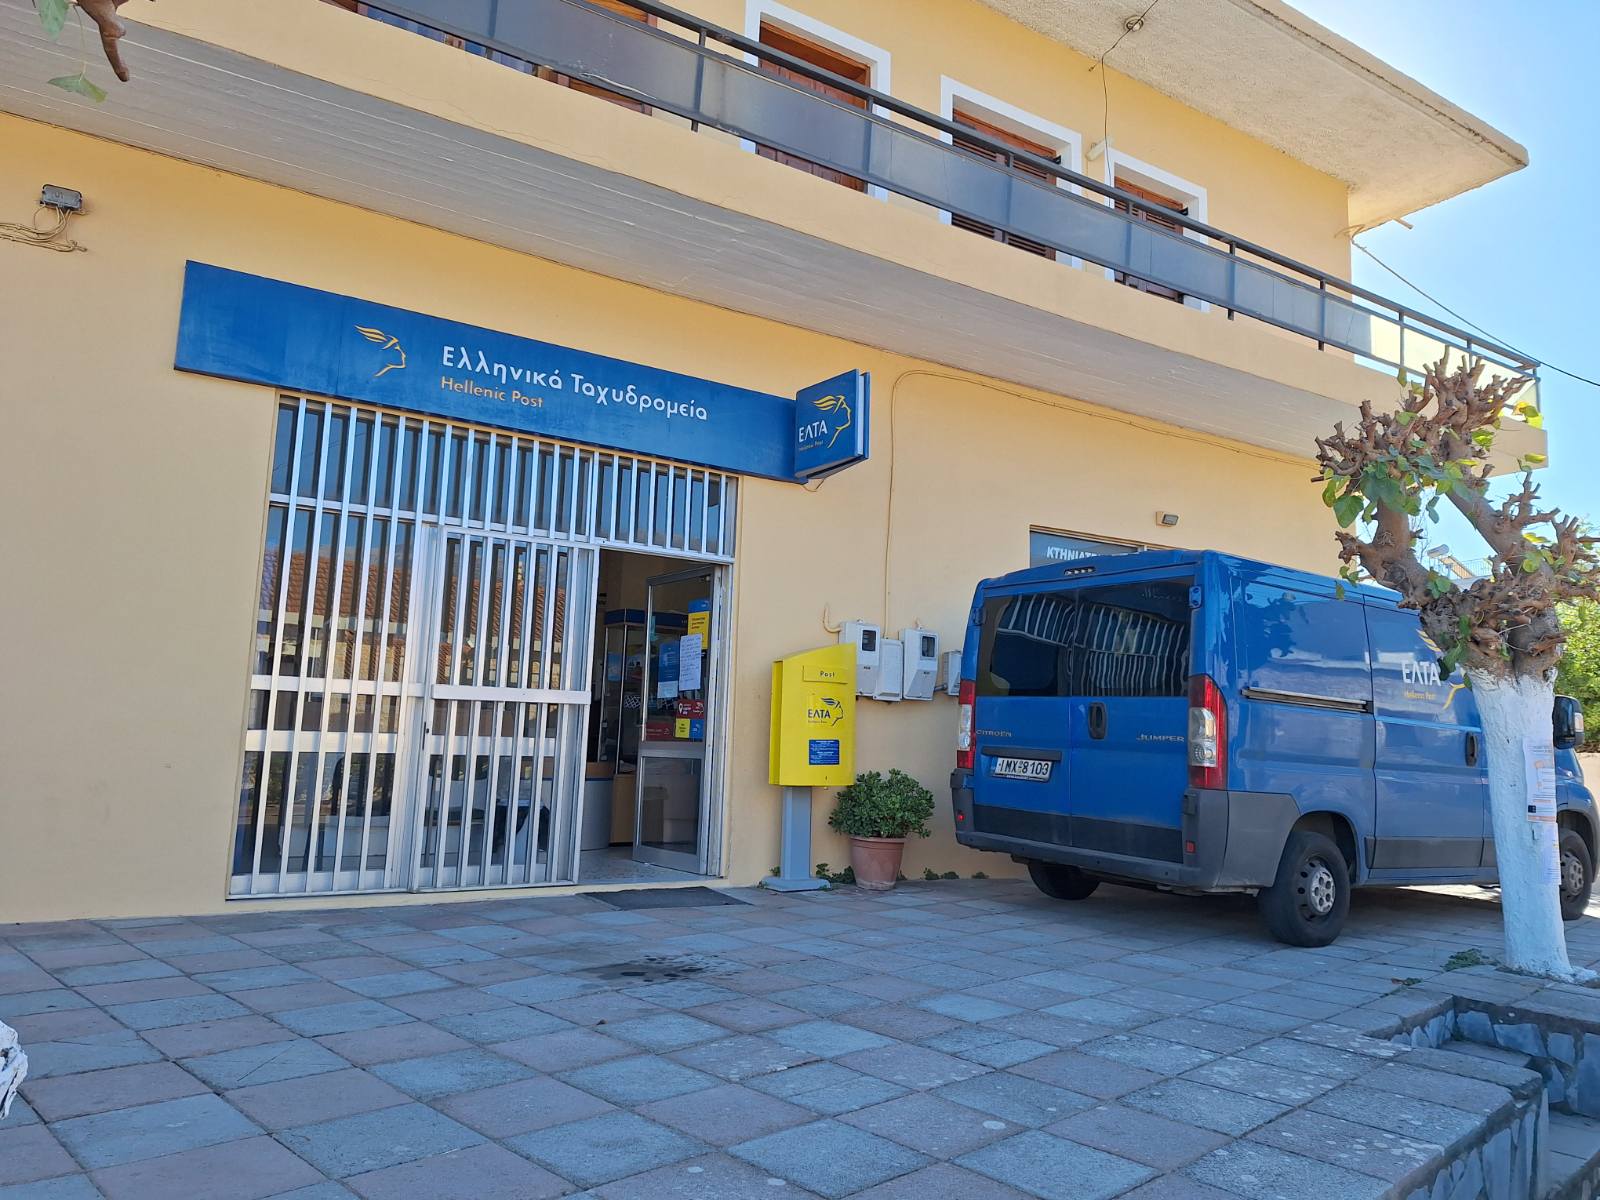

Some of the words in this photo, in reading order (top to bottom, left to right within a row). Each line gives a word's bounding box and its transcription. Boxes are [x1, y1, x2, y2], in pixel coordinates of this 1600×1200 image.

[440, 376, 506, 402] Hellenic
[511, 390, 544, 408] Post
[442, 345, 563, 389] Ελληνικά
[571, 373, 707, 420] Ταχυδρομεία
[798, 419, 828, 443] ΕΛΤΑ
[1401, 660, 1442, 686] ΕΛΤΑ
[808, 709, 831, 719] ΕΛΤΑ
[1136, 733, 1185, 742] JUMPER
